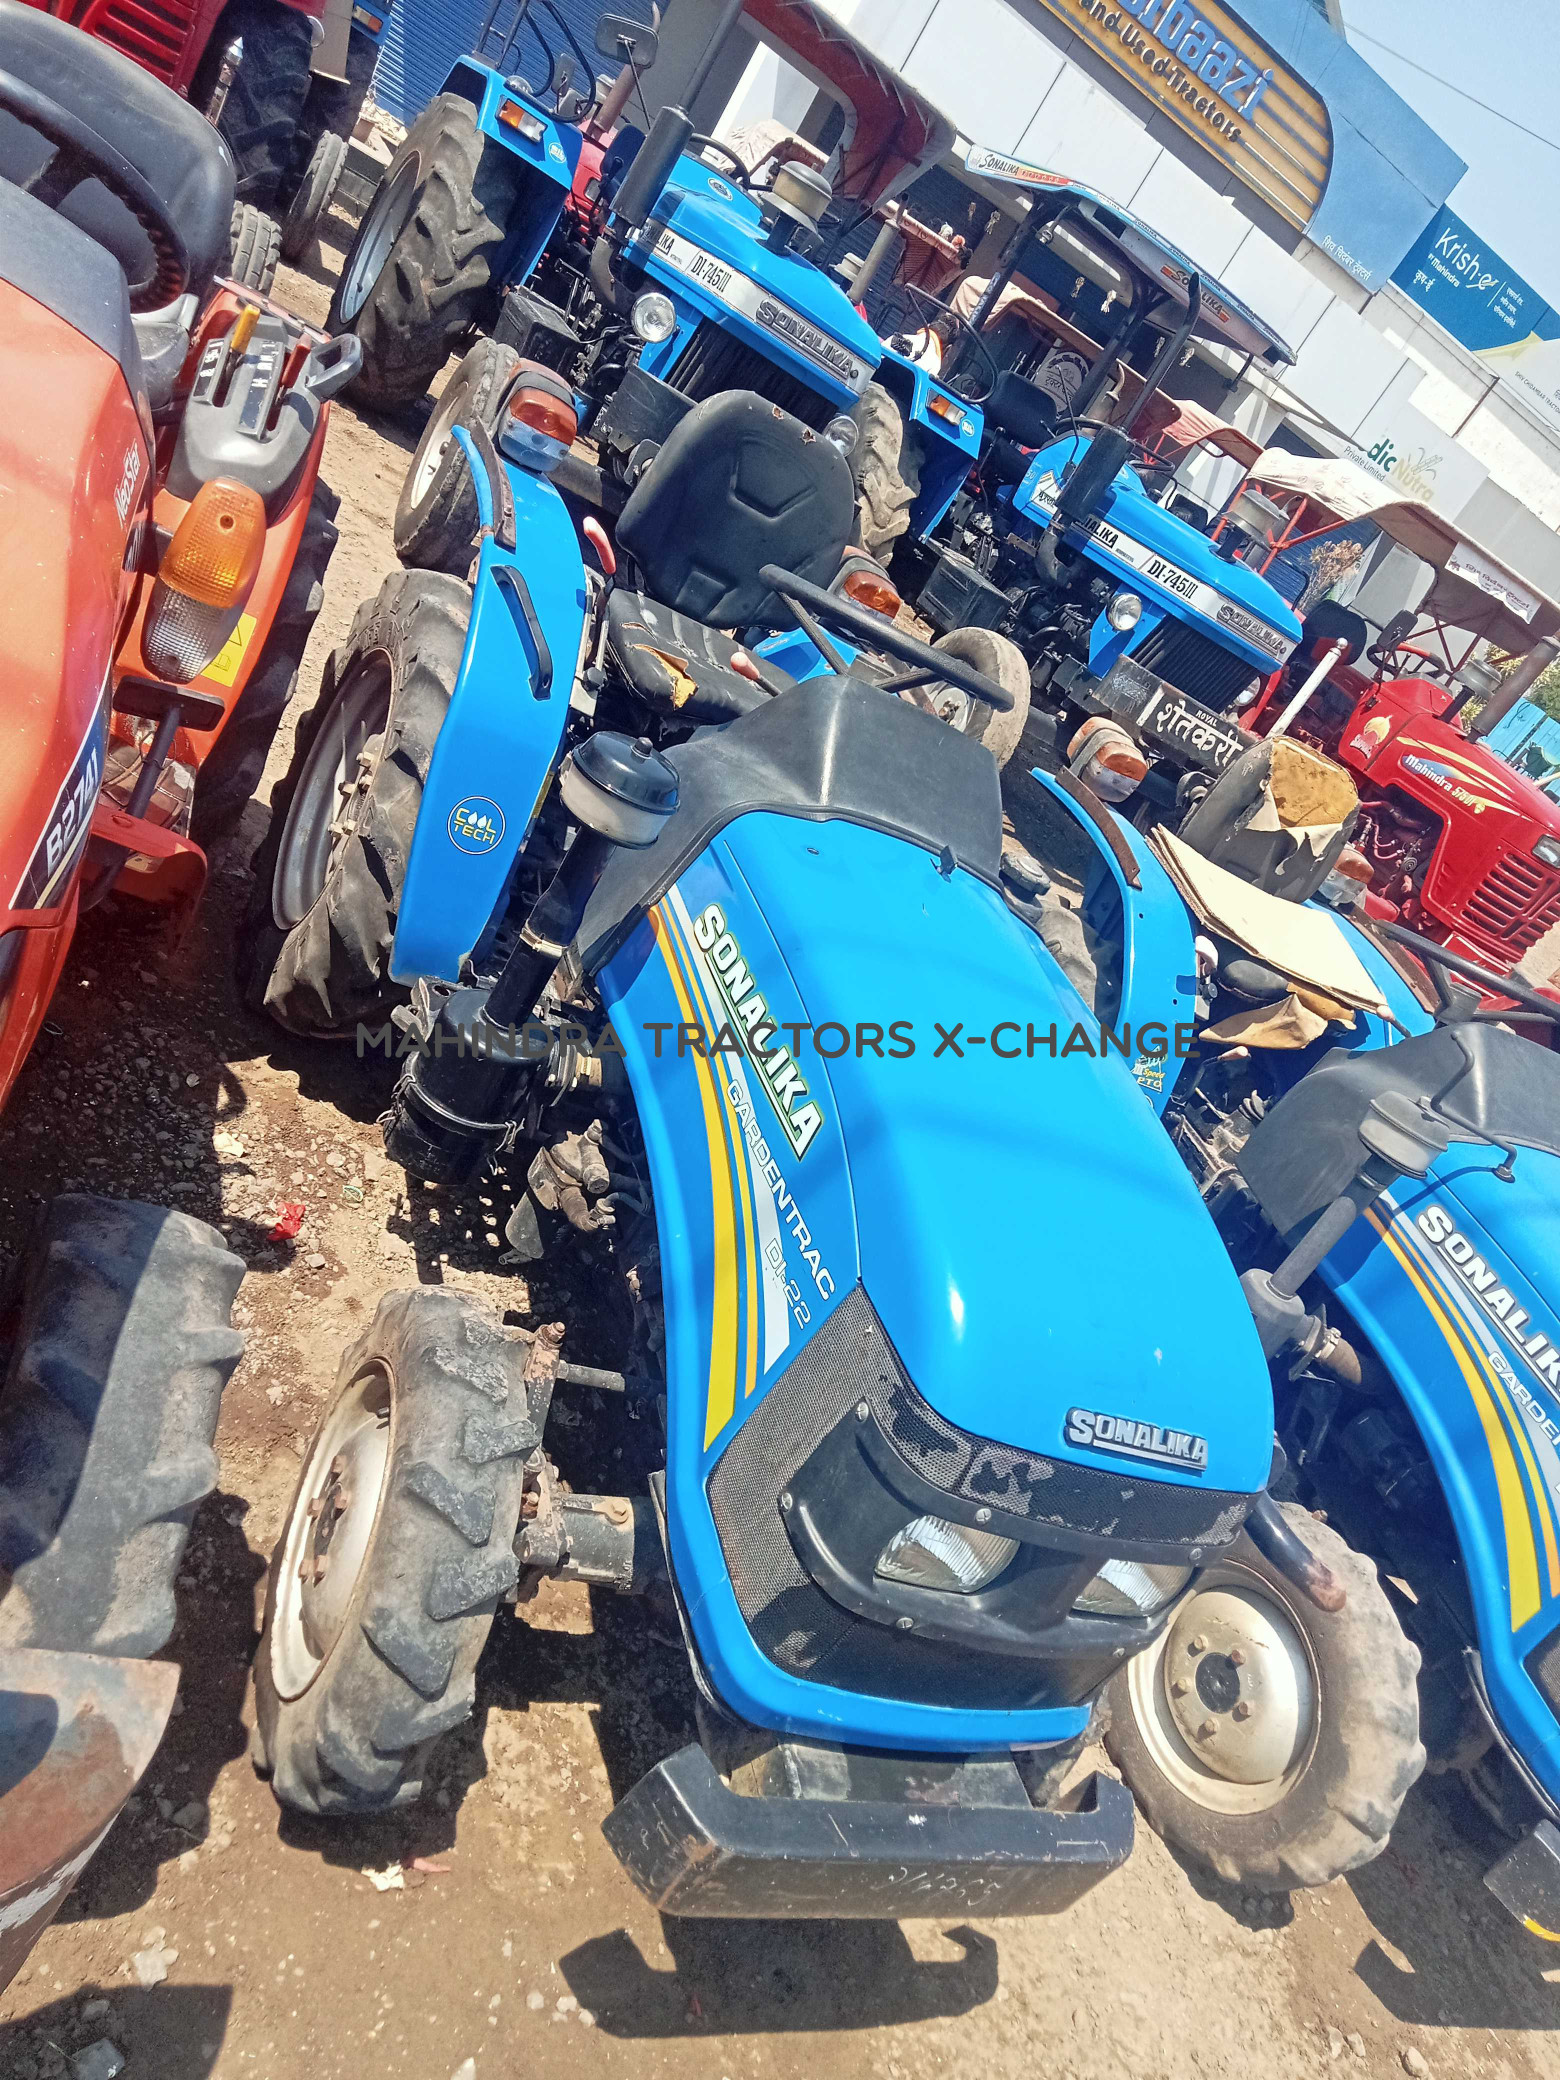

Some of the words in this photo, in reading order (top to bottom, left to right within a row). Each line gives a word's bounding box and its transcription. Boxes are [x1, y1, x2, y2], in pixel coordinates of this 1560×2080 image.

[1120, 22, 1171, 77] Used
[1167, 65, 1242, 142] Tractors
[979, 153, 1020, 176] SONALIKA
[1321, 234, 1336, 252] शिव
[1171, 270, 1224, 315] SOLIKA
[1431, 257, 1460, 288] Mahindra
[755, 299, 854, 379] SONALIKA
[1343, 445, 1366, 466] Private
[1363, 460, 1387, 482] Limited
[1391, 457, 1435, 503] Nutra
[1084, 517, 1119, 547] ALIKA
[1156, 698, 1244, 767] शेतकरी
[1194, 708, 1218, 728] ROYAL
[1404, 753, 1453, 792] Mahindra
[46, 747, 100, 878] B2741
[453, 819, 496, 845] TECH
[693, 903, 823, 1162] SONALIKA
[1136, 1076, 1163, 1089] PTO
[1143, 1068, 1166, 1079] Speed
[726, 1078, 836, 1302] GARDENTRAC
[764, 1237, 812, 1331] DI-22
[1417, 1205, 1560, 1393] SONALIK
[1067, 1408, 1209, 1470] SONALIKA
